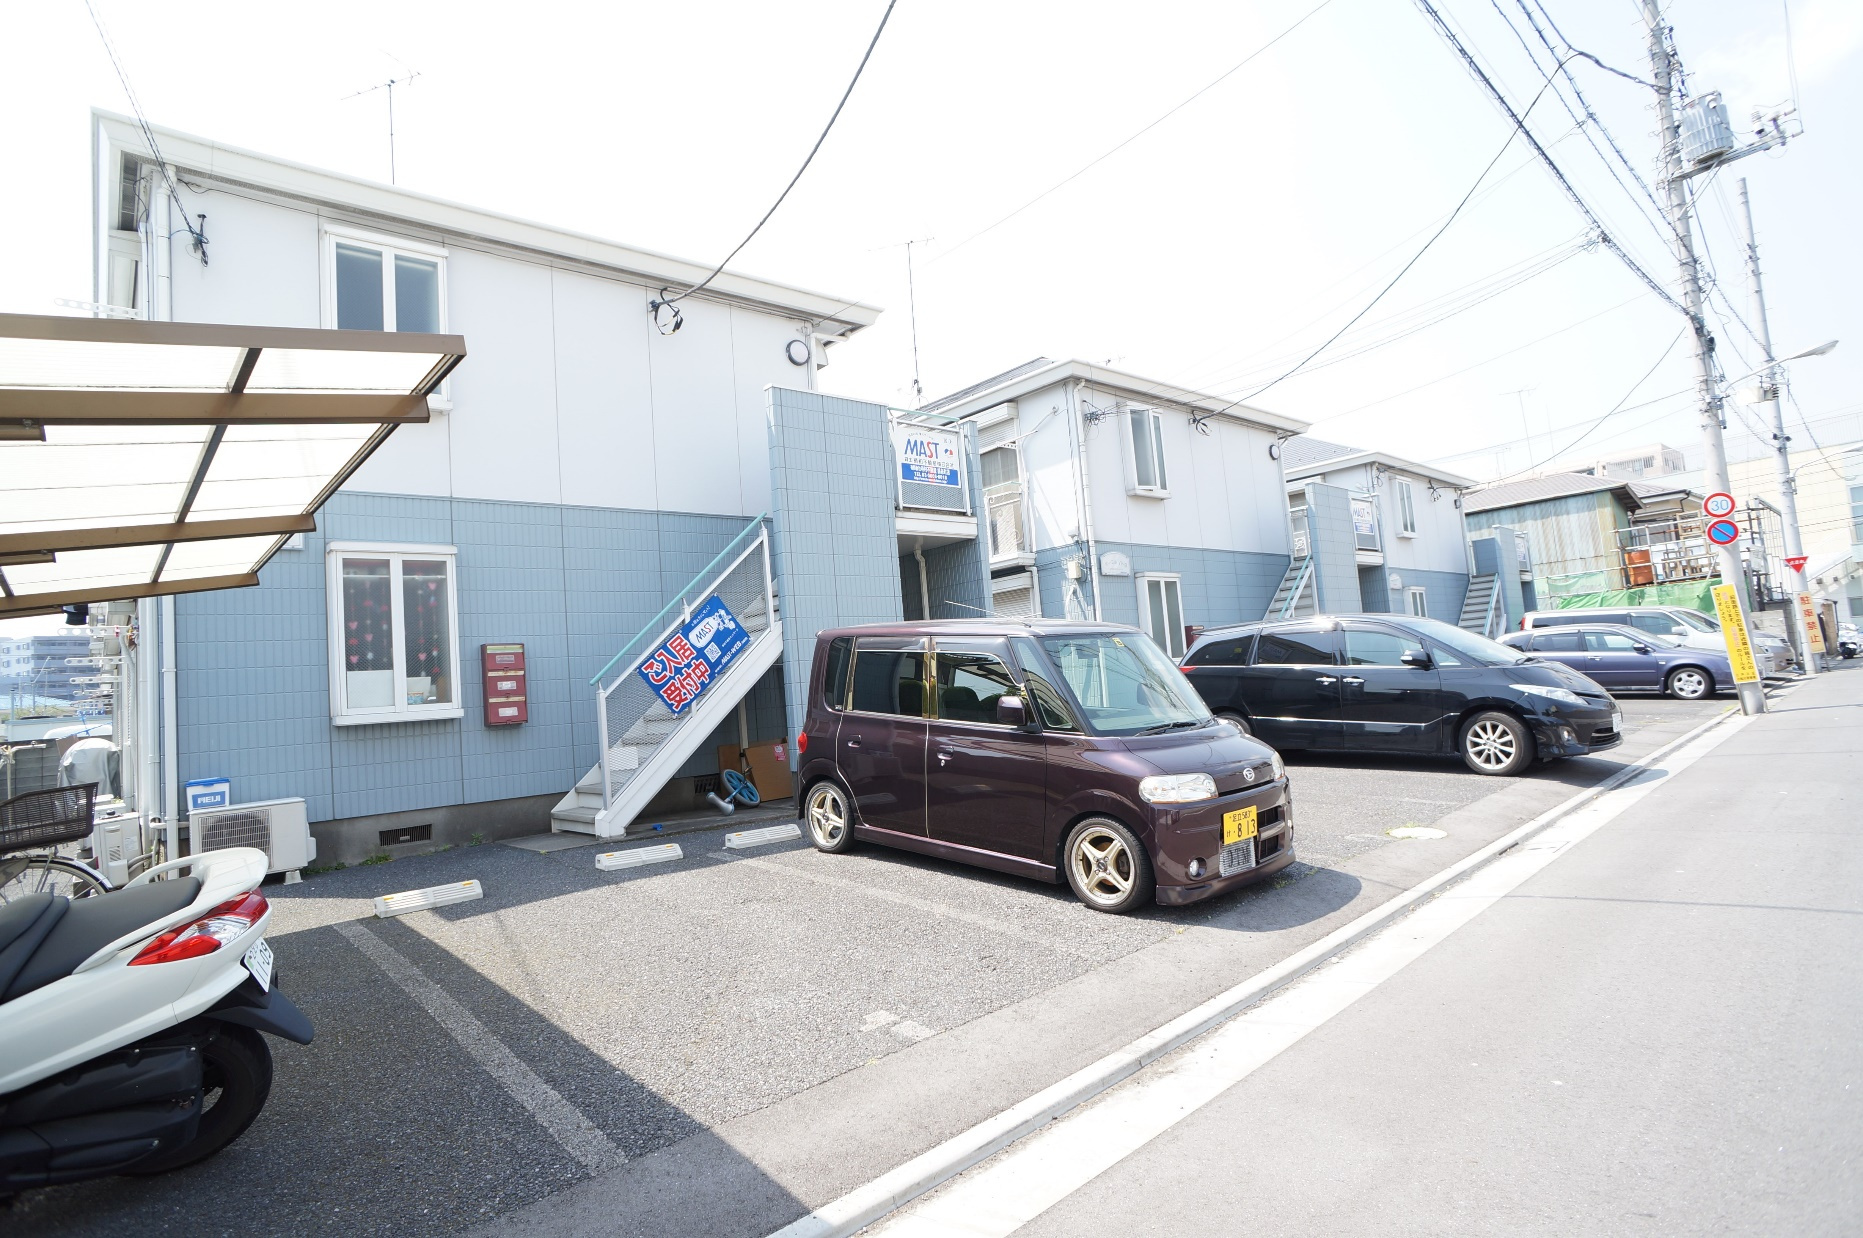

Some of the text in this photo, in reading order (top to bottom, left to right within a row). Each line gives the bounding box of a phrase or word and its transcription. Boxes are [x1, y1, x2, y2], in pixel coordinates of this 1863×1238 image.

[904, 438, 939, 459] MAST
[1711, 499, 1729, 512] 30
[1799, 595, 1822, 644] 駐車禁止
[695, 621, 715, 643] MAST
[641, 633, 697, 684] ご入居
[660, 658, 711, 711] 受付中
[197, 795, 221, 804] MEIJI
